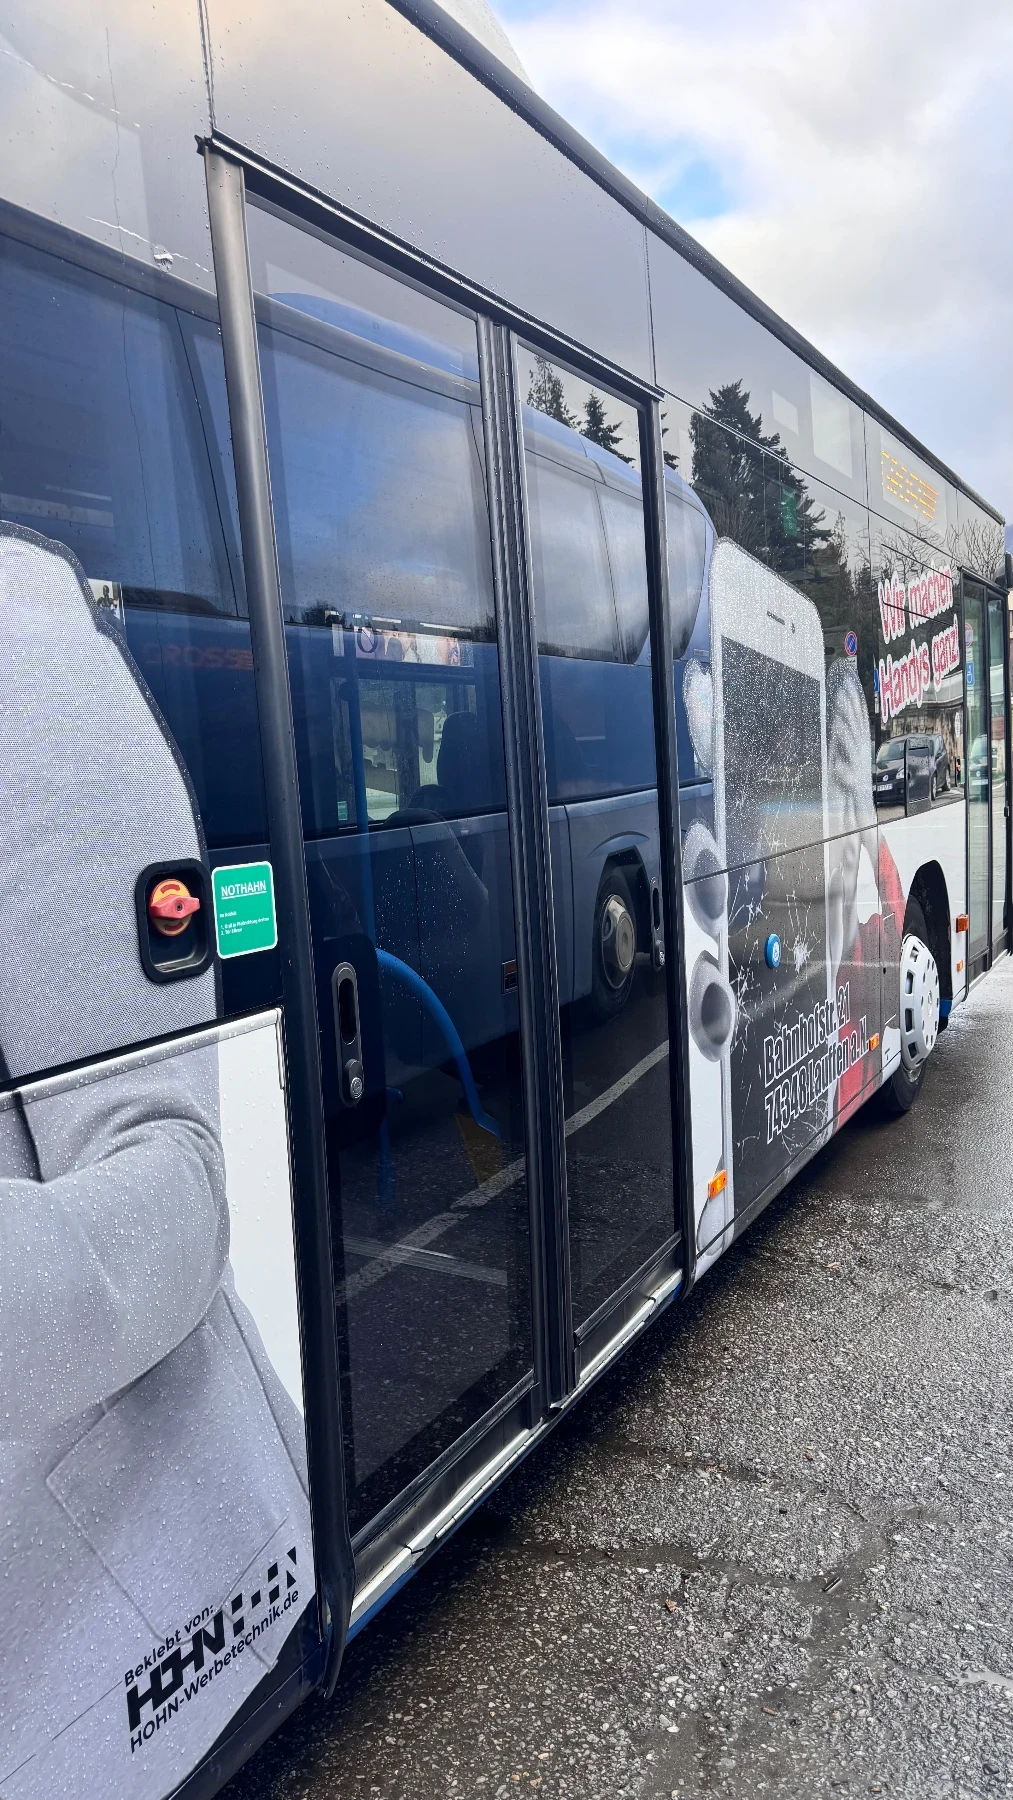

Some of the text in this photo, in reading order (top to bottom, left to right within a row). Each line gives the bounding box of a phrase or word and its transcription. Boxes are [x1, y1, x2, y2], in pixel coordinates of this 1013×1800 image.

[878, 560, 953, 644] Wir machen
[879, 639, 930, 723] Handys
[221, 880, 267, 897] NOTHAHN
[763, 981, 850, 1088] Bahnhofstr. 21
[764, 1065, 809, 1145] 74348
[808, 1034, 850, 1105] Lauffen
[850, 1030, 860, 1066] a.
[125, 1604, 214, 1687] Beklebt von:
[126, 1610, 225, 1733] HOHN
[130, 1590, 299, 1754] HOHN-Werbetechnik.de
